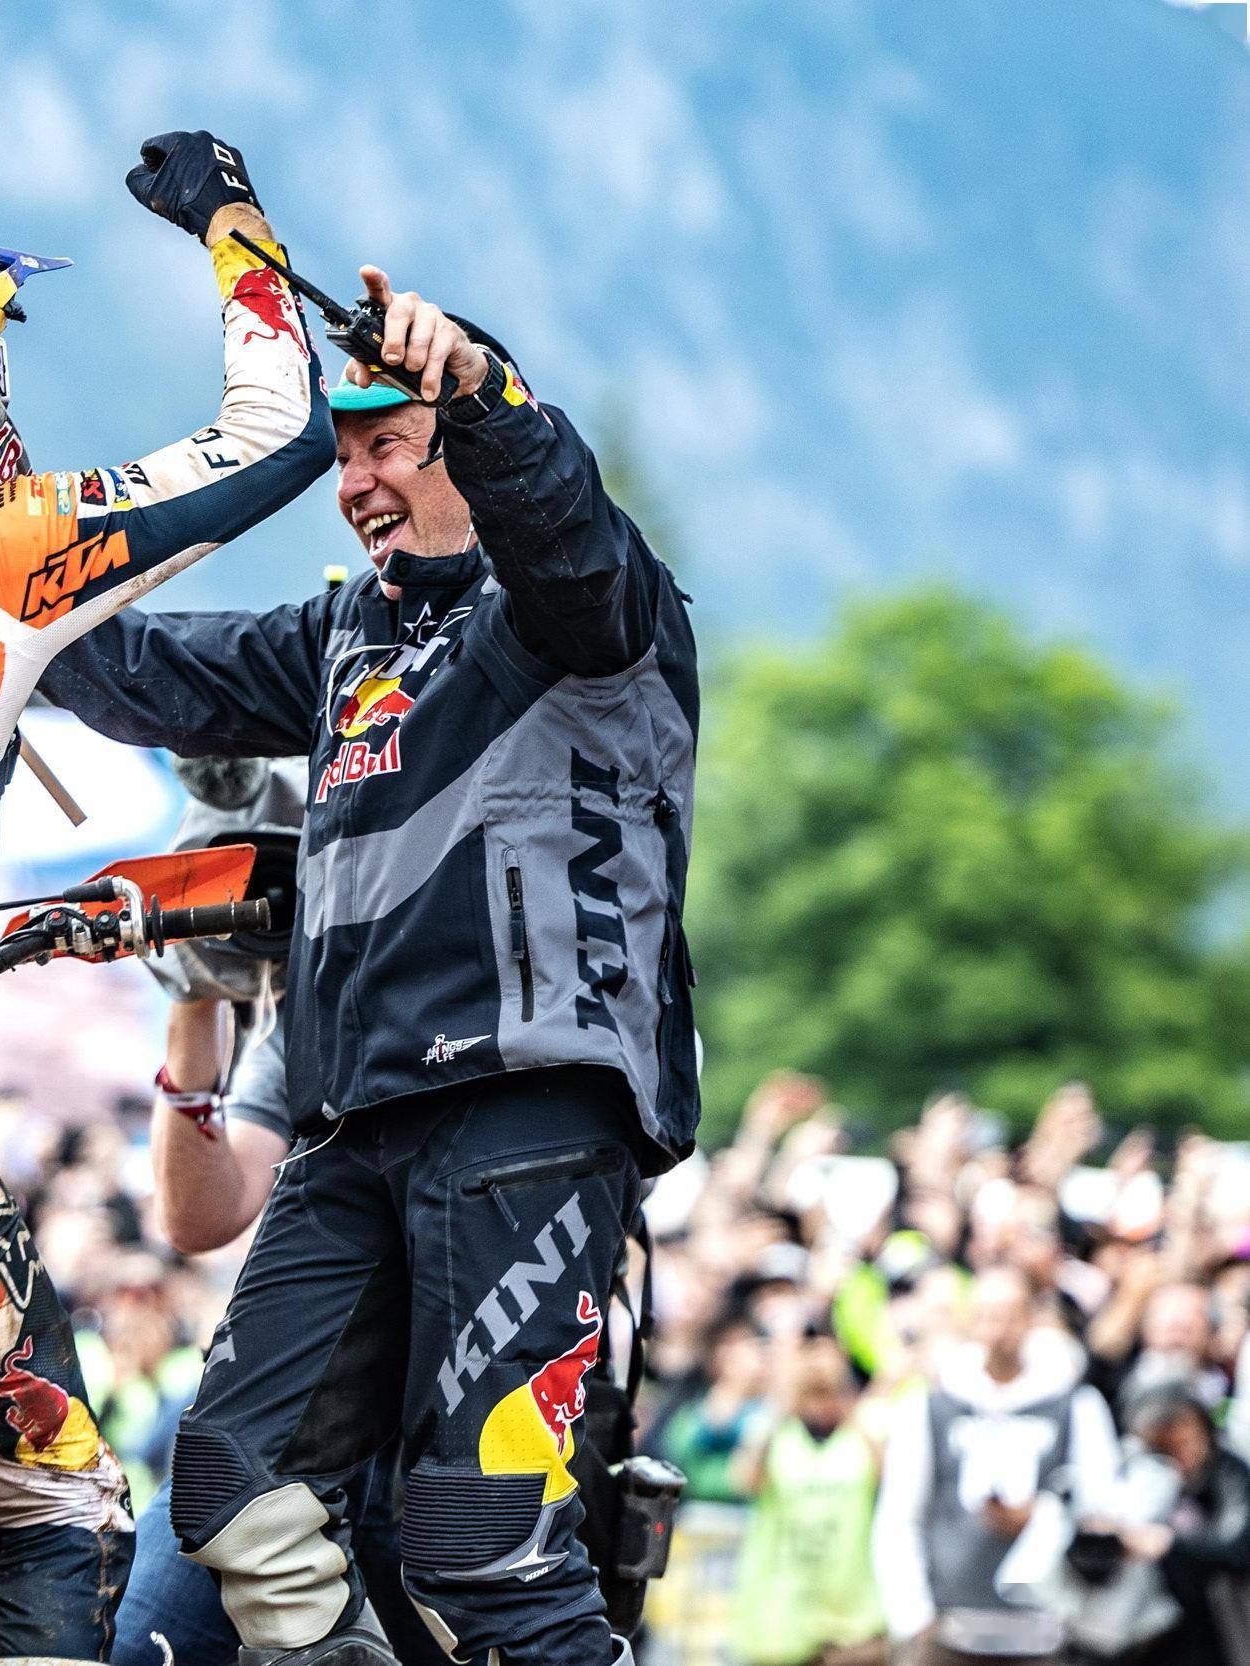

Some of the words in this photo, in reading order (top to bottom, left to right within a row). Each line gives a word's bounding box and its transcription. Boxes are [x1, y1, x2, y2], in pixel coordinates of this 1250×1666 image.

[212, 142, 249, 191] FO
[191, 427, 241, 469] FO
[21, 530, 130, 624] KTM
[343, 727, 402, 784] Bull
[567, 745, 629, 1034] KINI
[436, 1191, 594, 1417] KINI
